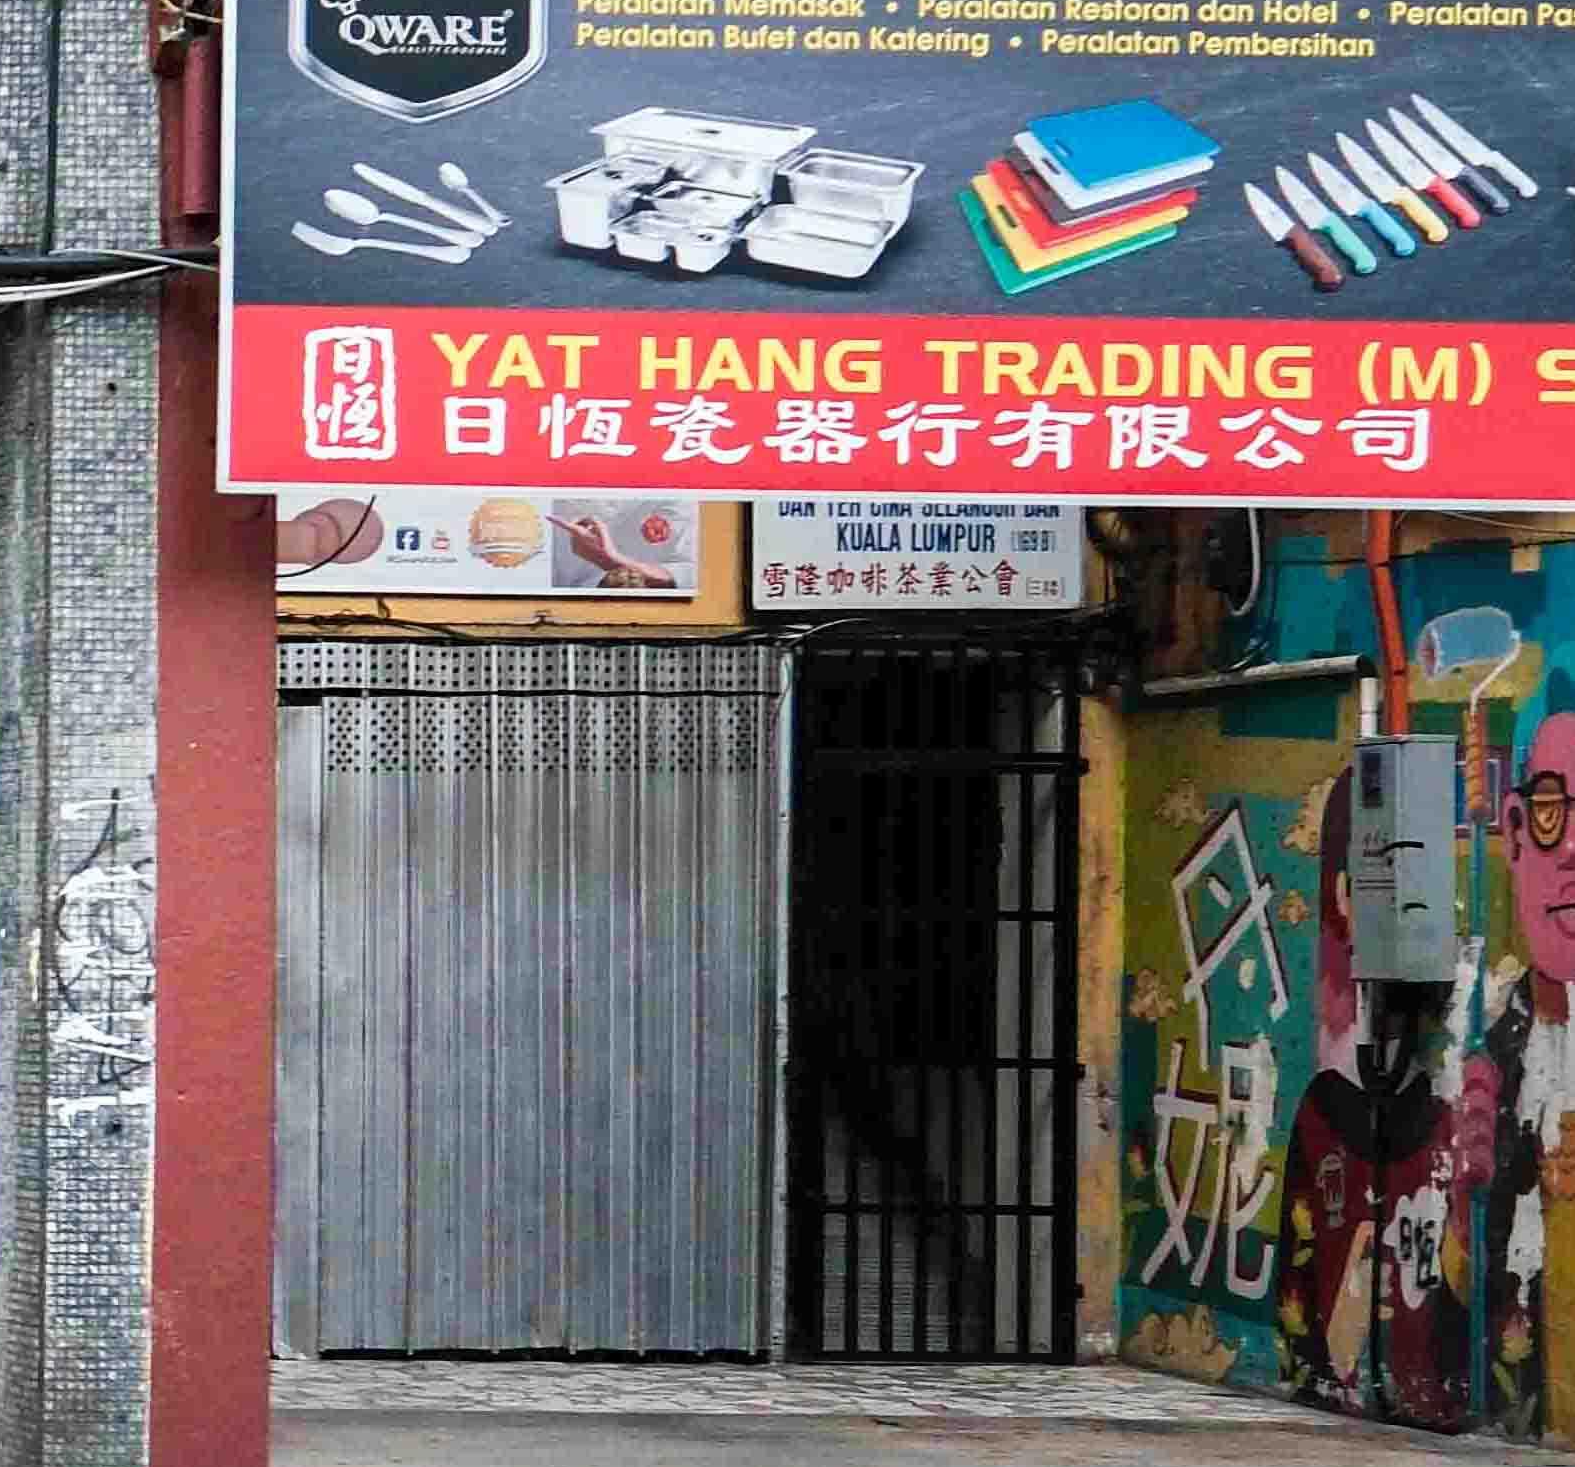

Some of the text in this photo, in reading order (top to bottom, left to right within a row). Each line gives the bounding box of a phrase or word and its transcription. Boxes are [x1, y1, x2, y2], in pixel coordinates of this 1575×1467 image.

[1263, 0, 1338, 25] Hotel
[1390, 0, 1528, 27] Peralatan
[1537, 2, 1575, 27] Pa
[576, 22, 1377, 58] Peralatan Bufet dan Katering Peralatan Pembersihan
[430, 332, 601, 391] YAT
[639, 335, 884, 395] HANG
[924, 339, 1315, 401] TRADING
[1358, 341, 1492, 407] (M)
[836, 522, 901, 553] KUALA
[911, 522, 996, 553] LUMPUR
